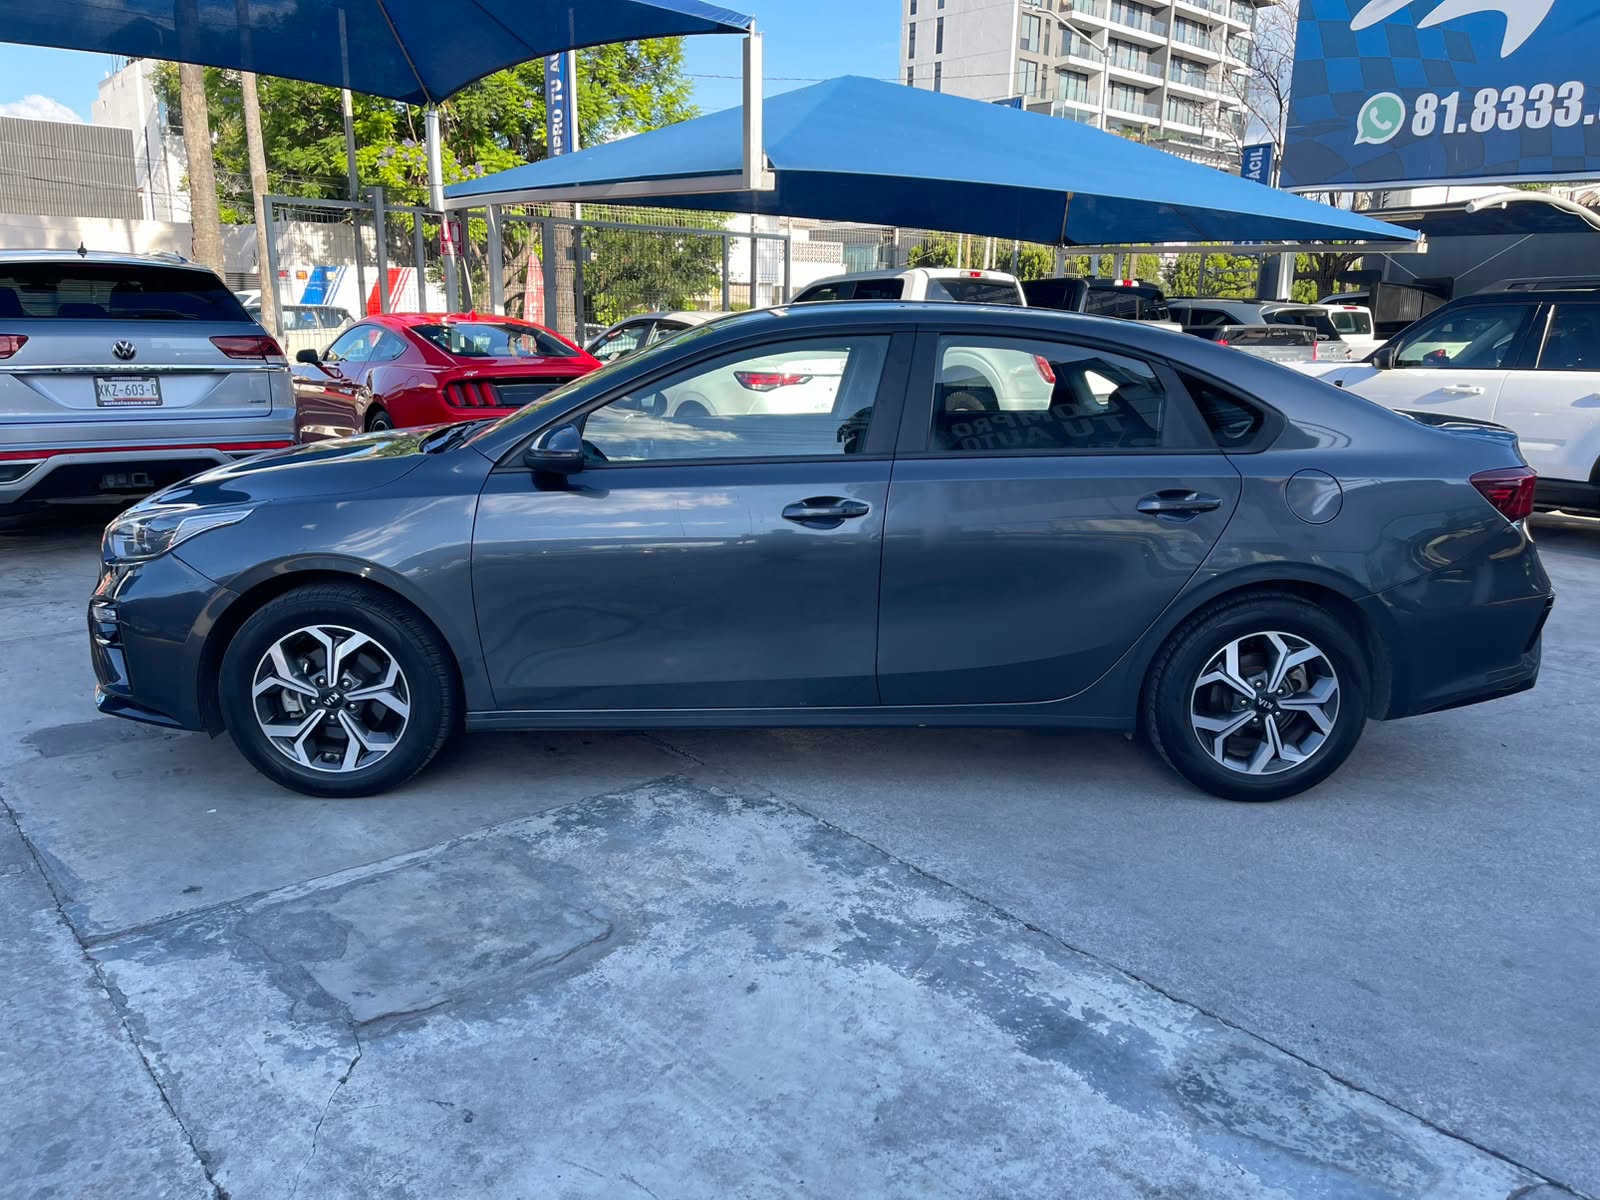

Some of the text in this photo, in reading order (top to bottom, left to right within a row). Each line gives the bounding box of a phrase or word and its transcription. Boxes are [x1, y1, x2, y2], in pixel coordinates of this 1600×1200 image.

[550, 79, 563, 105] TU
[1411, 80, 1600, 137] 81.8333.
[1245, 147, 1264, 181] ÁCIL
[323, 692, 340, 706] KIA
[1258, 697, 1274, 710] KIA
